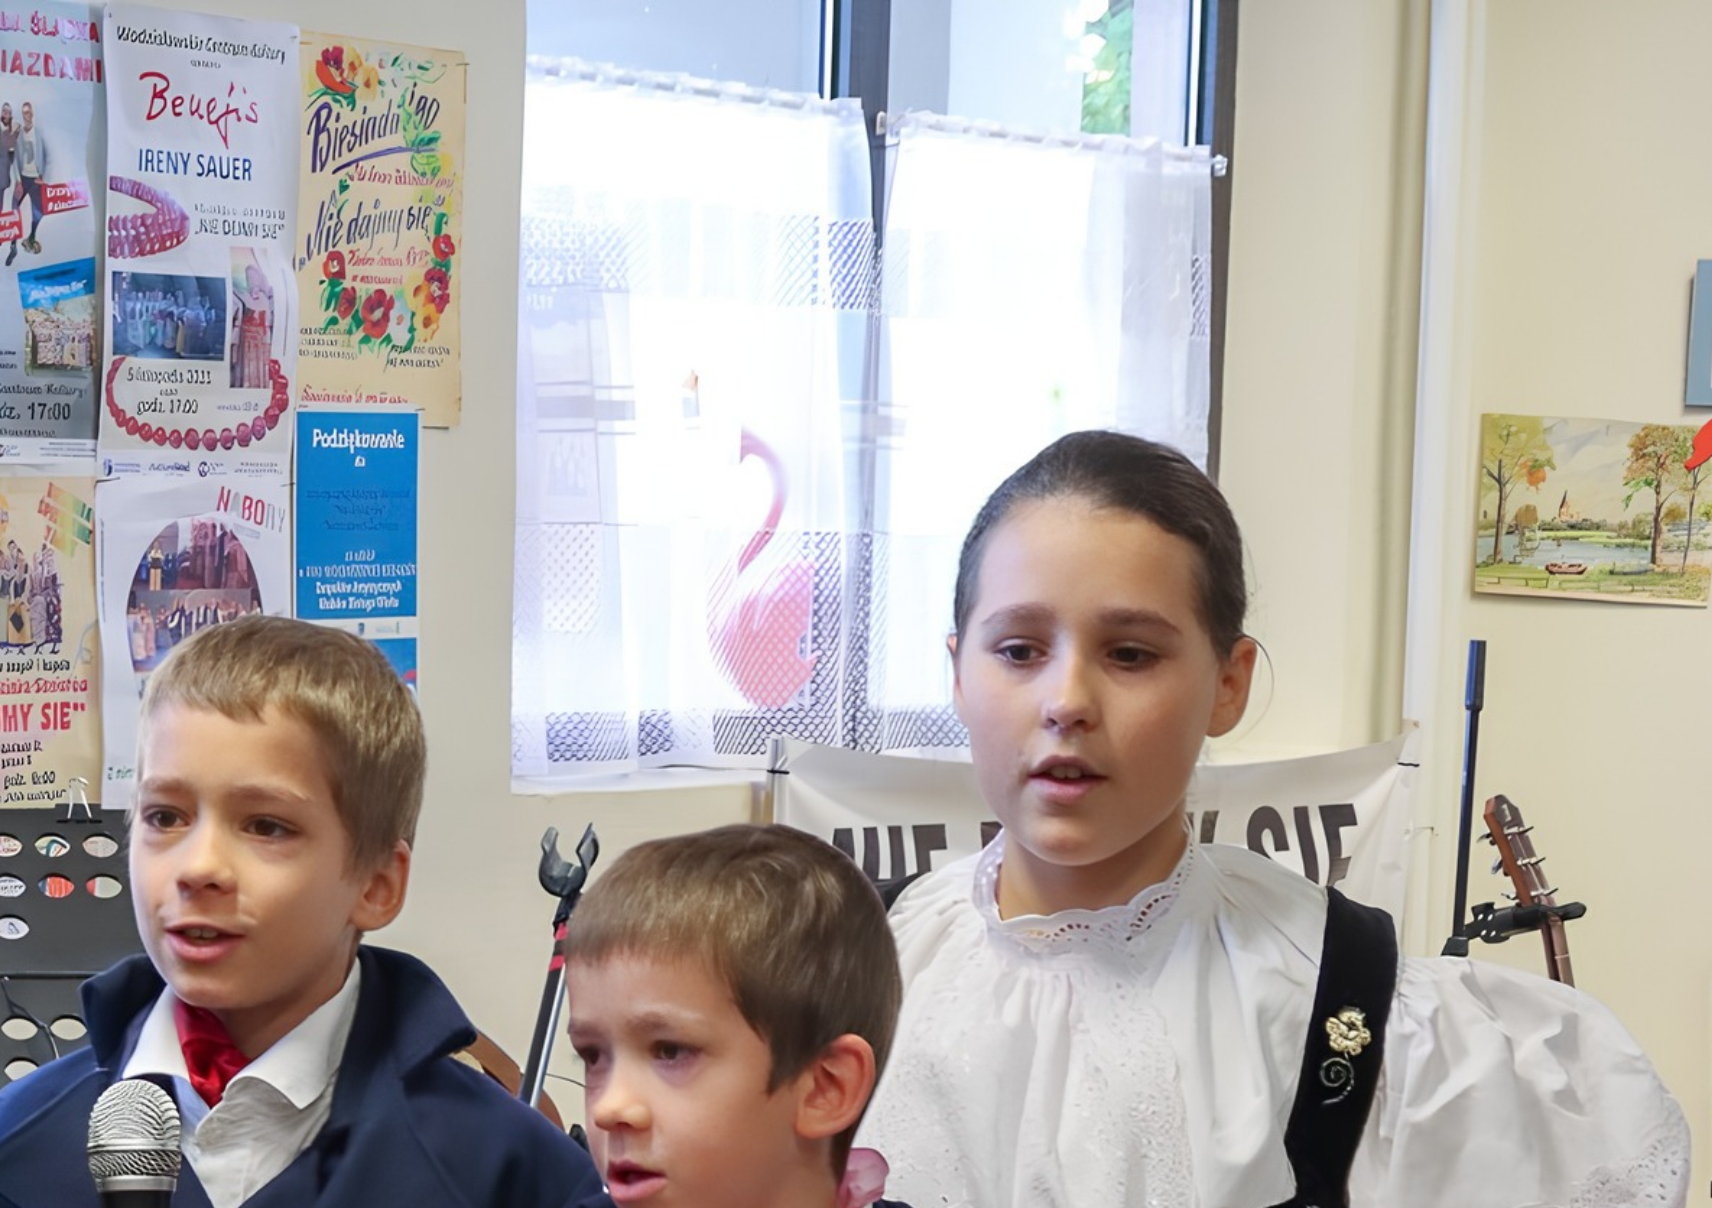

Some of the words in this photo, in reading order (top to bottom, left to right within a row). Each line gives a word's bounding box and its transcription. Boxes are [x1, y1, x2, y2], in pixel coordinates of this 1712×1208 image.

[138, 71, 258, 150] Benefis
[138, 148, 191, 176] IRENY
[196, 154, 253, 182] SAUER
